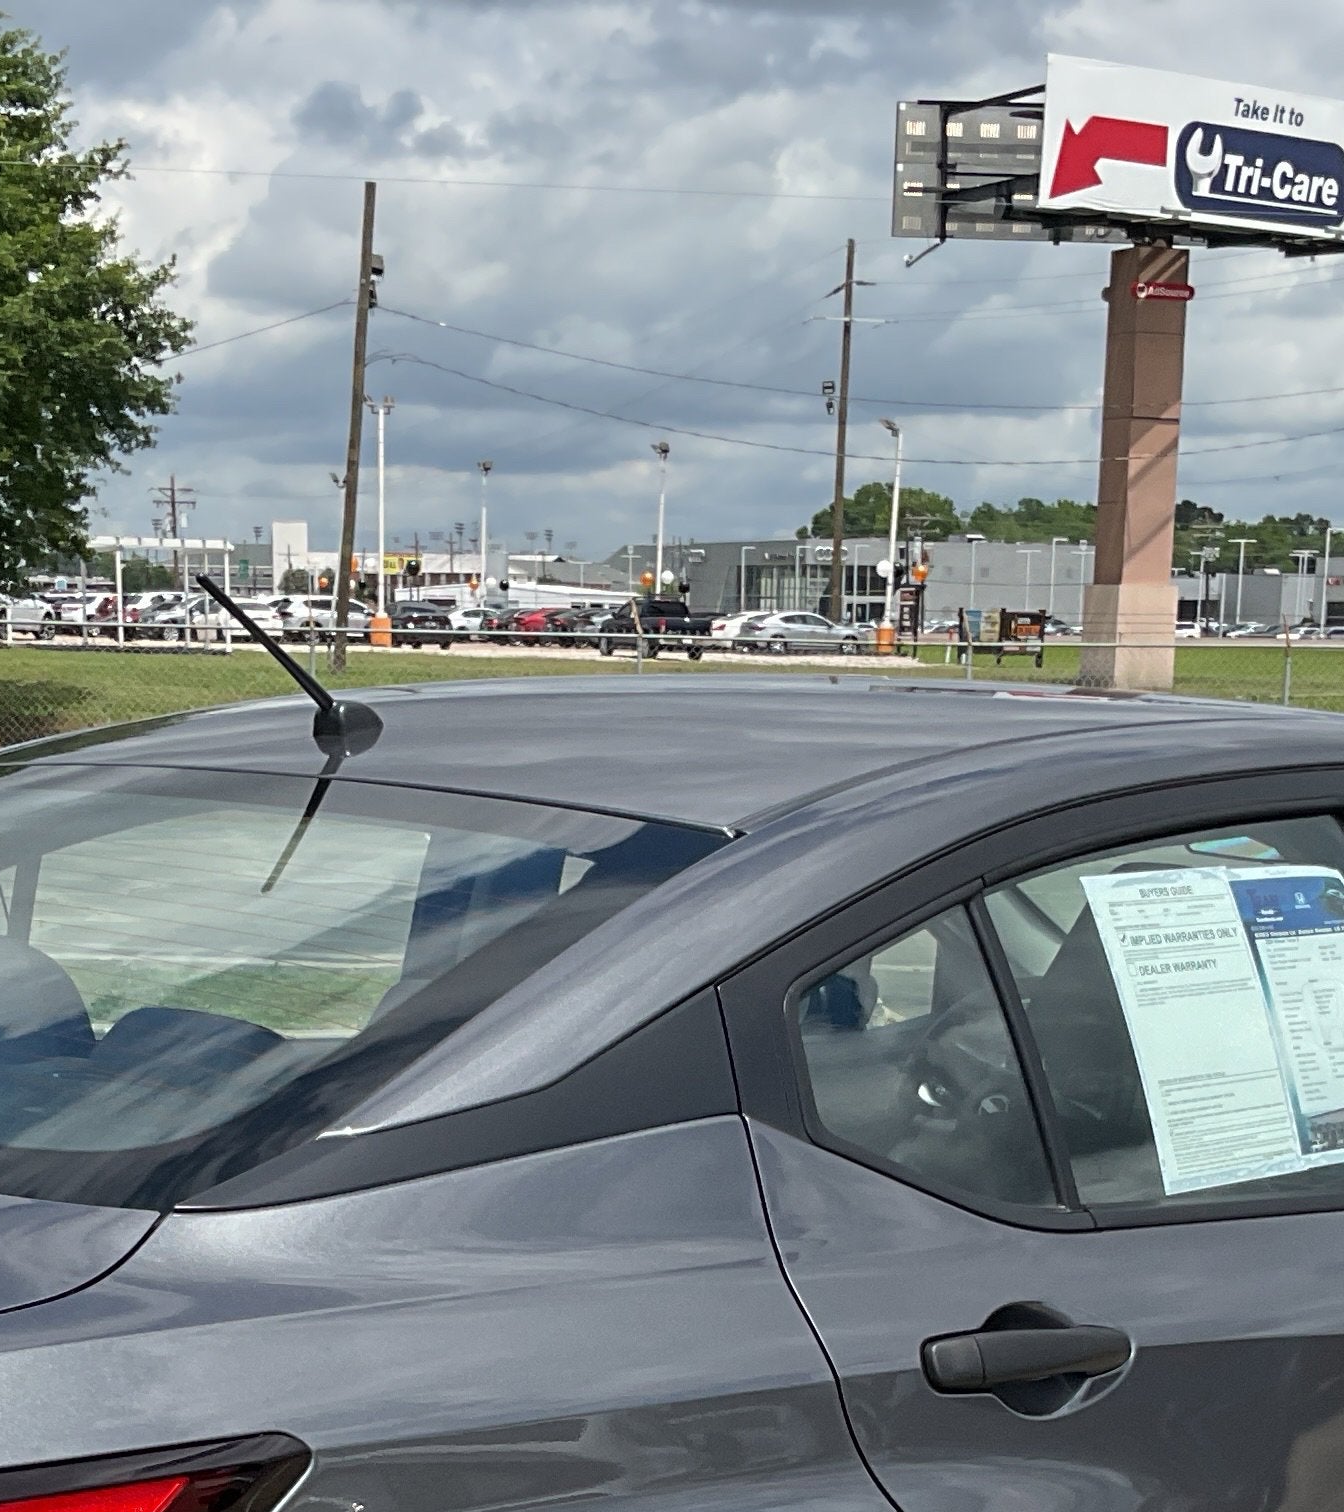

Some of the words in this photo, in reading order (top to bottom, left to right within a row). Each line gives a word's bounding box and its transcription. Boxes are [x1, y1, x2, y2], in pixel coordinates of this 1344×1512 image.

[1234, 97, 1269, 121] Take
[1273, 104, 1285, 124] It
[1289, 107, 1304, 127] to
[1223, 153, 1339, 206] Tri-Care
[1139, 886, 1169, 898] BUYERS
[1170, 885, 1194, 896] GUIDE
[1130, 935, 1162, 947] IMPLIED
[1163, 929, 1215, 944] WARRANTIES
[1217, 926, 1238, 939] ONLY
[1139, 963, 1171, 977] DEALER
[1173, 959, 1217, 973] WARRANTY
